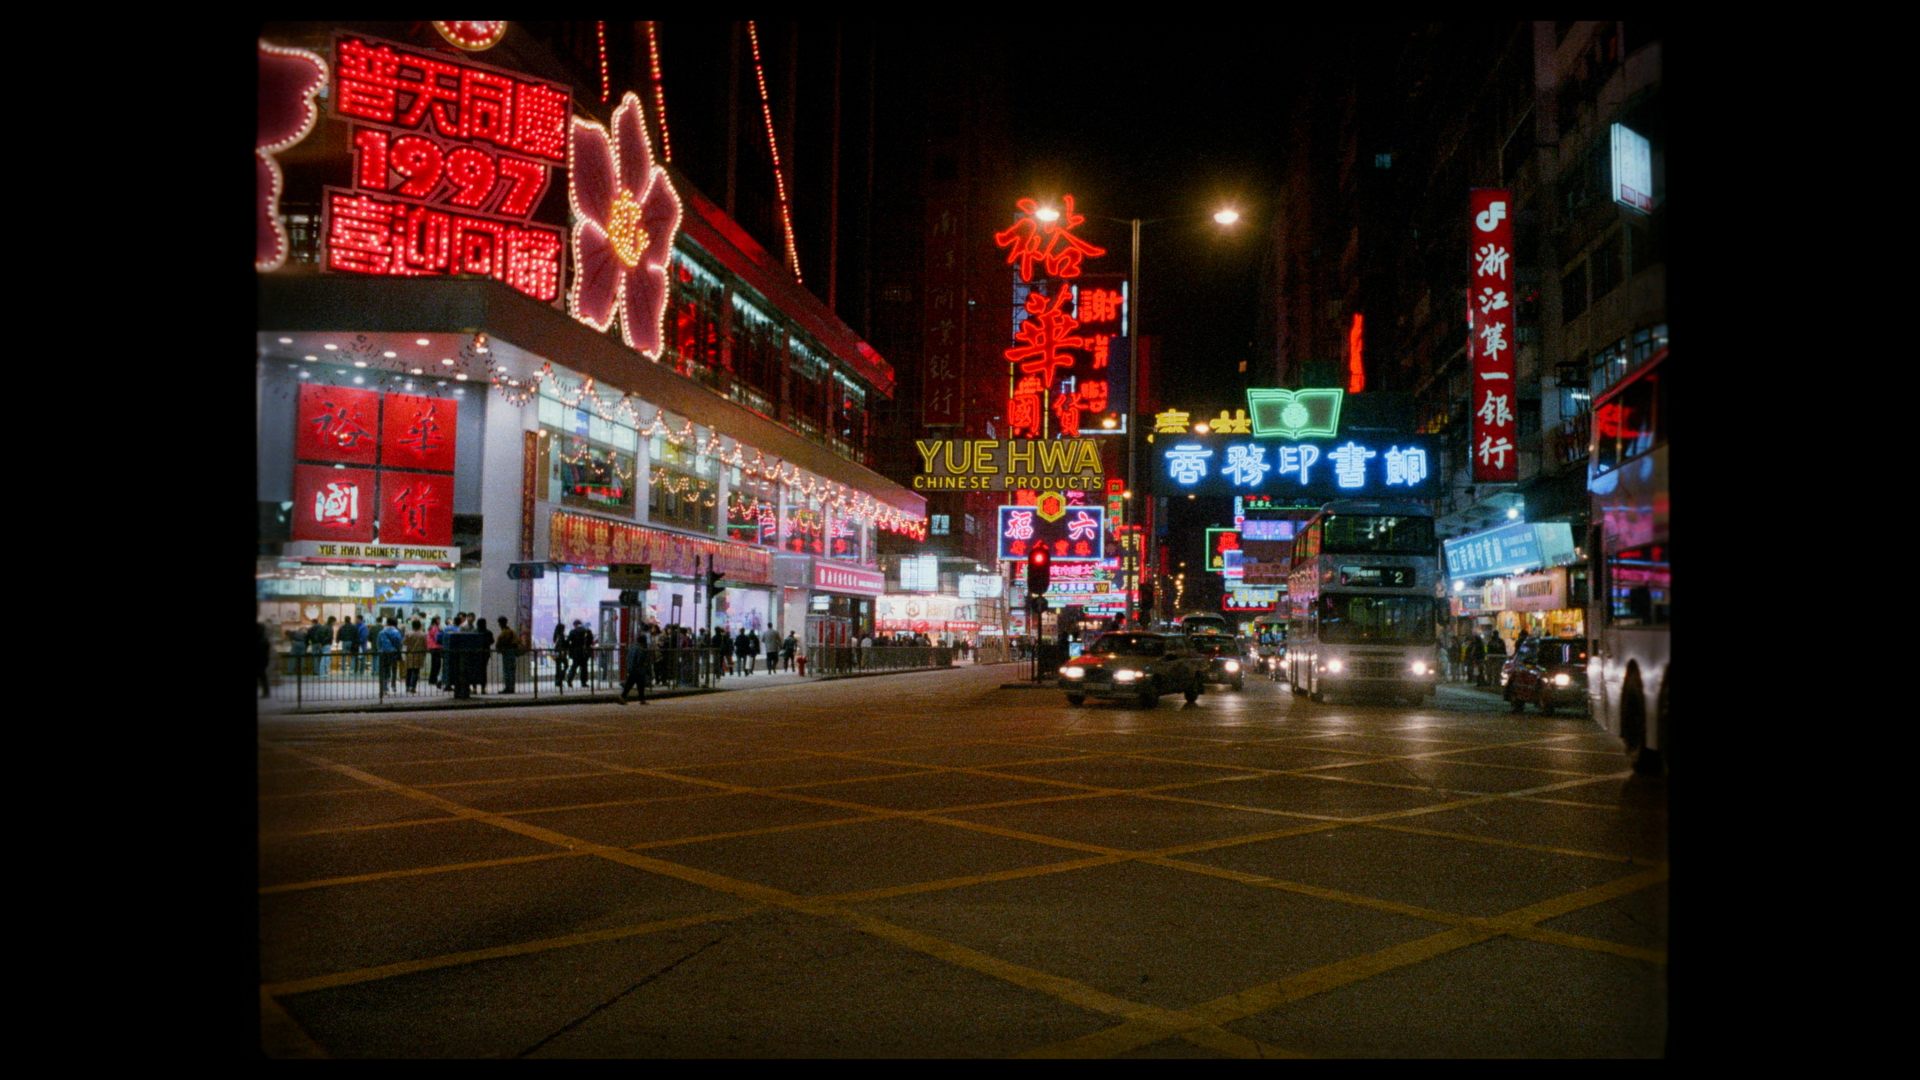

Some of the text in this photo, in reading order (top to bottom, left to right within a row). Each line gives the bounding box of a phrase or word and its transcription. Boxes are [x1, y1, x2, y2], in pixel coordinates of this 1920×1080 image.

[337, 38, 568, 160] 普天同慶
[355, 129, 546, 215] 1997
[1475, 243, 1513, 470] 浙江第一銀行
[916, 440, 1103, 474] YUE HWA
[1165, 442, 1427, 488] 商務印書館
[914, 476, 1103, 490] CHINESE PRODUCTS
[319, 543, 448, 559] YUE HWA CHINESE PRODUCTS
[1394, 570, 1404, 583] 2
